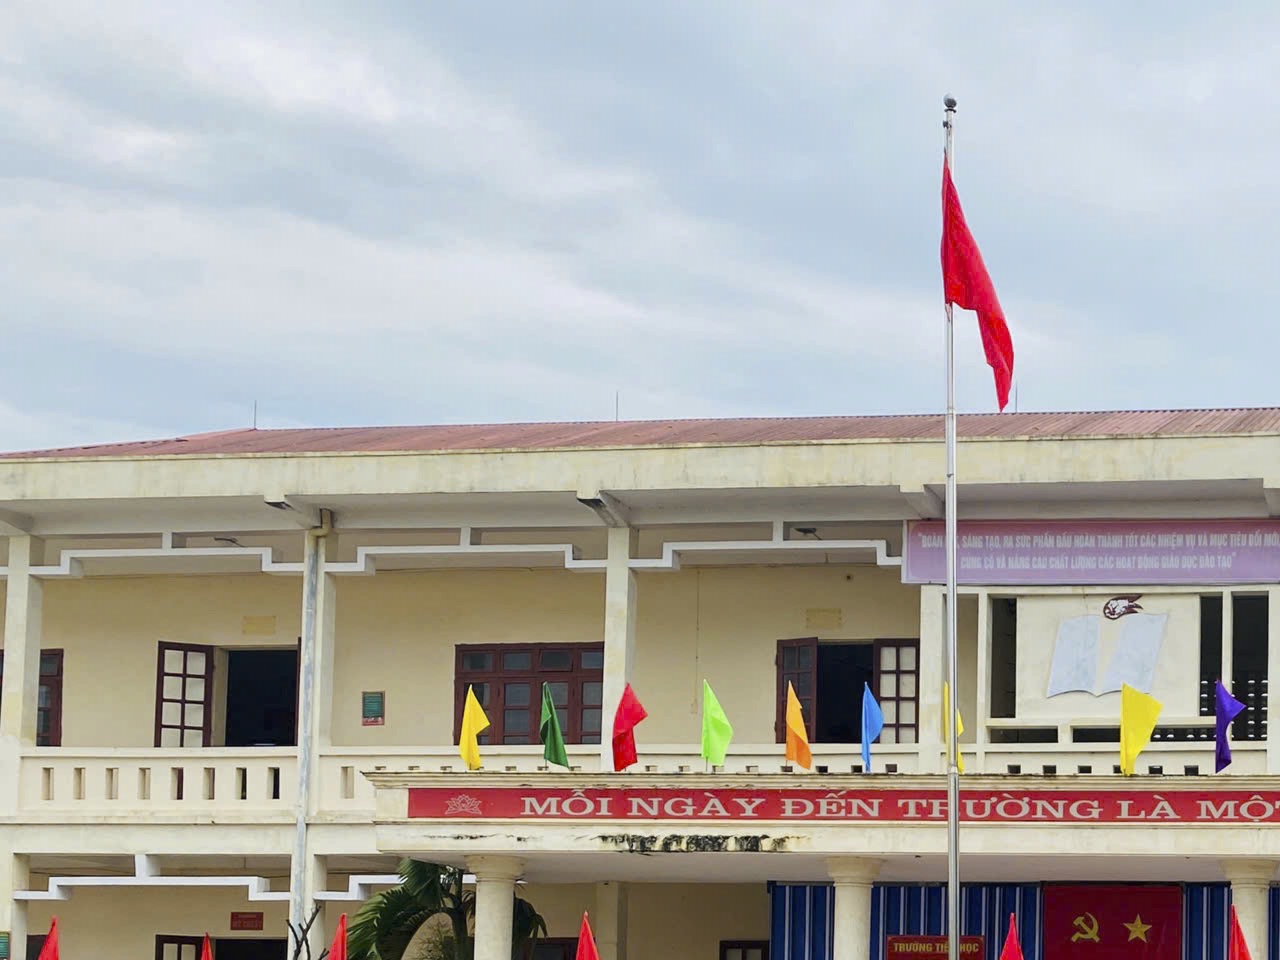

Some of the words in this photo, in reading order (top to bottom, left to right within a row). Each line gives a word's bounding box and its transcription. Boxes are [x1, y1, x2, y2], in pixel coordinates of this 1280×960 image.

[520, 788, 613, 816] MỖI
[627, 792, 766, 817] NGÀY
[780, 790, 883, 817] ĐẾN
[1116, 794, 1181, 819] LÀ
[960, 943, 979, 955] HỌC
